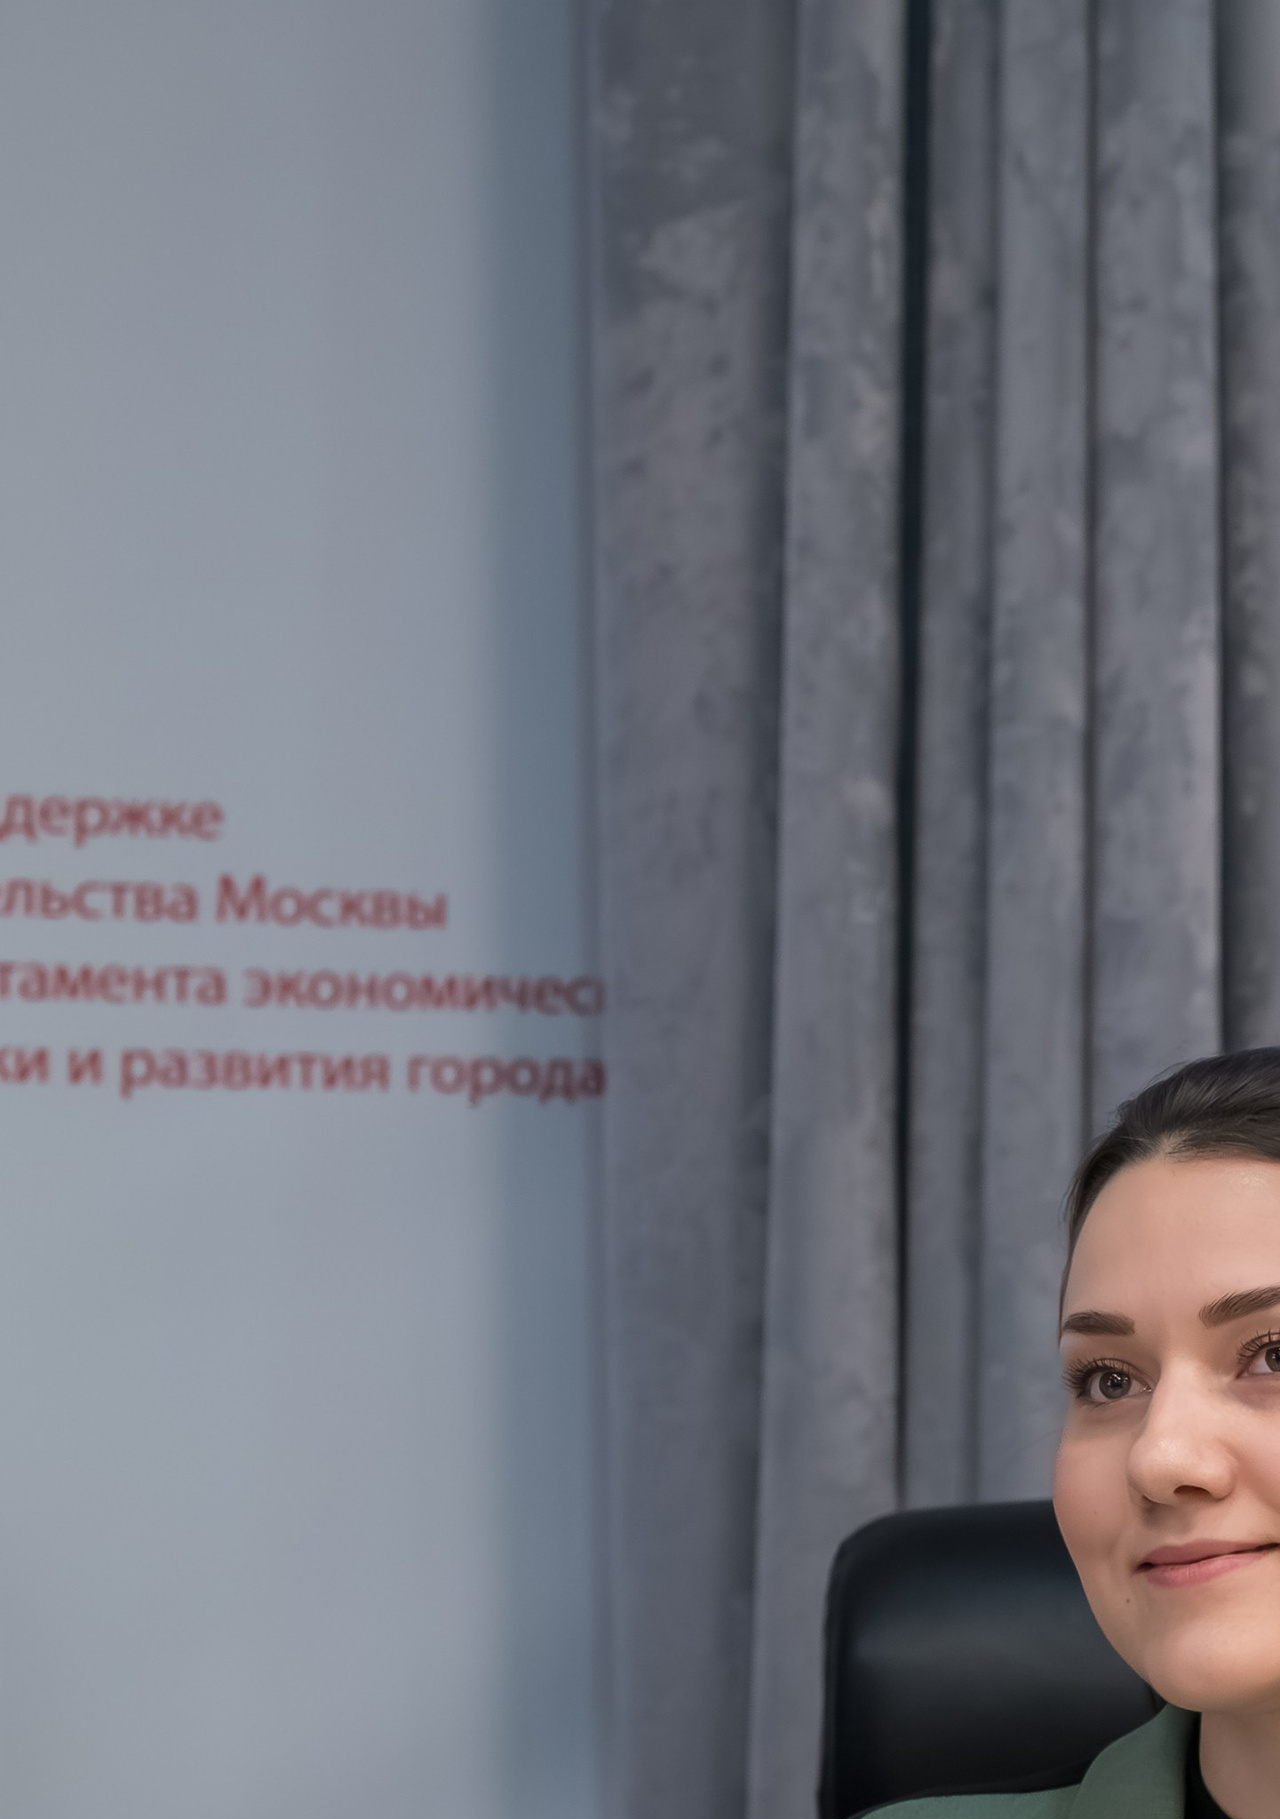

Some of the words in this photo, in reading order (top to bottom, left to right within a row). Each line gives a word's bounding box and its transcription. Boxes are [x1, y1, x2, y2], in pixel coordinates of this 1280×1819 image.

[0, 794, 224, 848] держке
[215, 874, 448, 930] Москвы
[66, 1048, 103, 1086] и
[118, 1048, 391, 1102] развития
[406, 1056, 608, 1108] города
